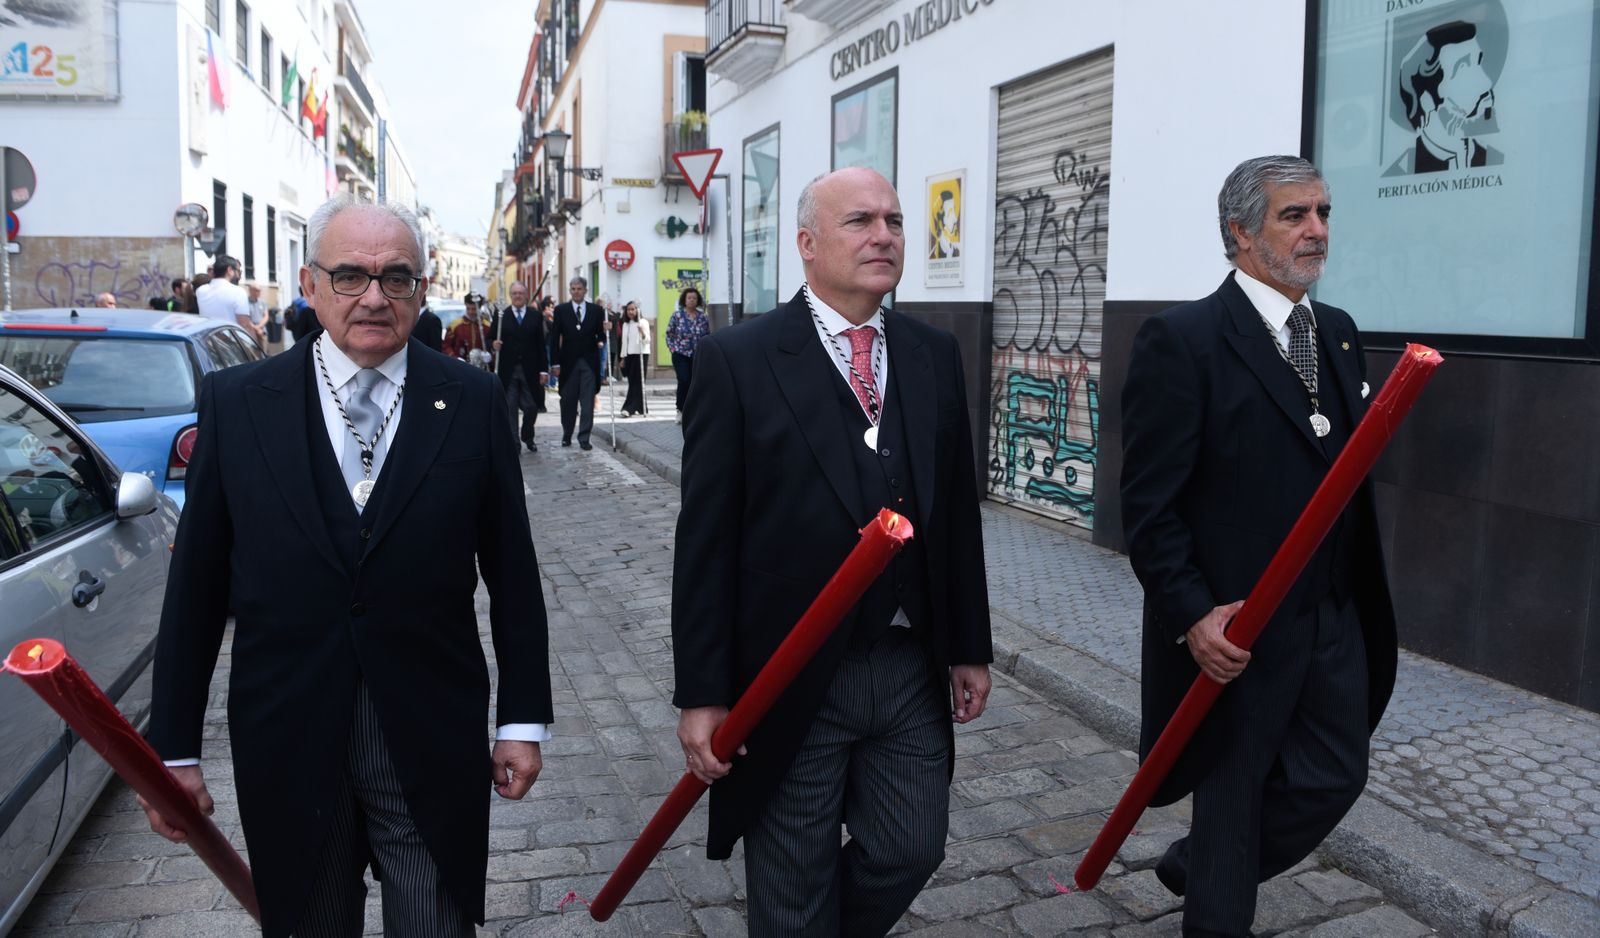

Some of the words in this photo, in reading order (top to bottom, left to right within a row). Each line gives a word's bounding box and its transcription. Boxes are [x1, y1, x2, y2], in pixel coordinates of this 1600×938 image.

[830, 20, 900, 81] CENTRO
[1378, 178, 1449, 198] PERITACIÓN
[1452, 174, 1503, 191] MÉDICA
